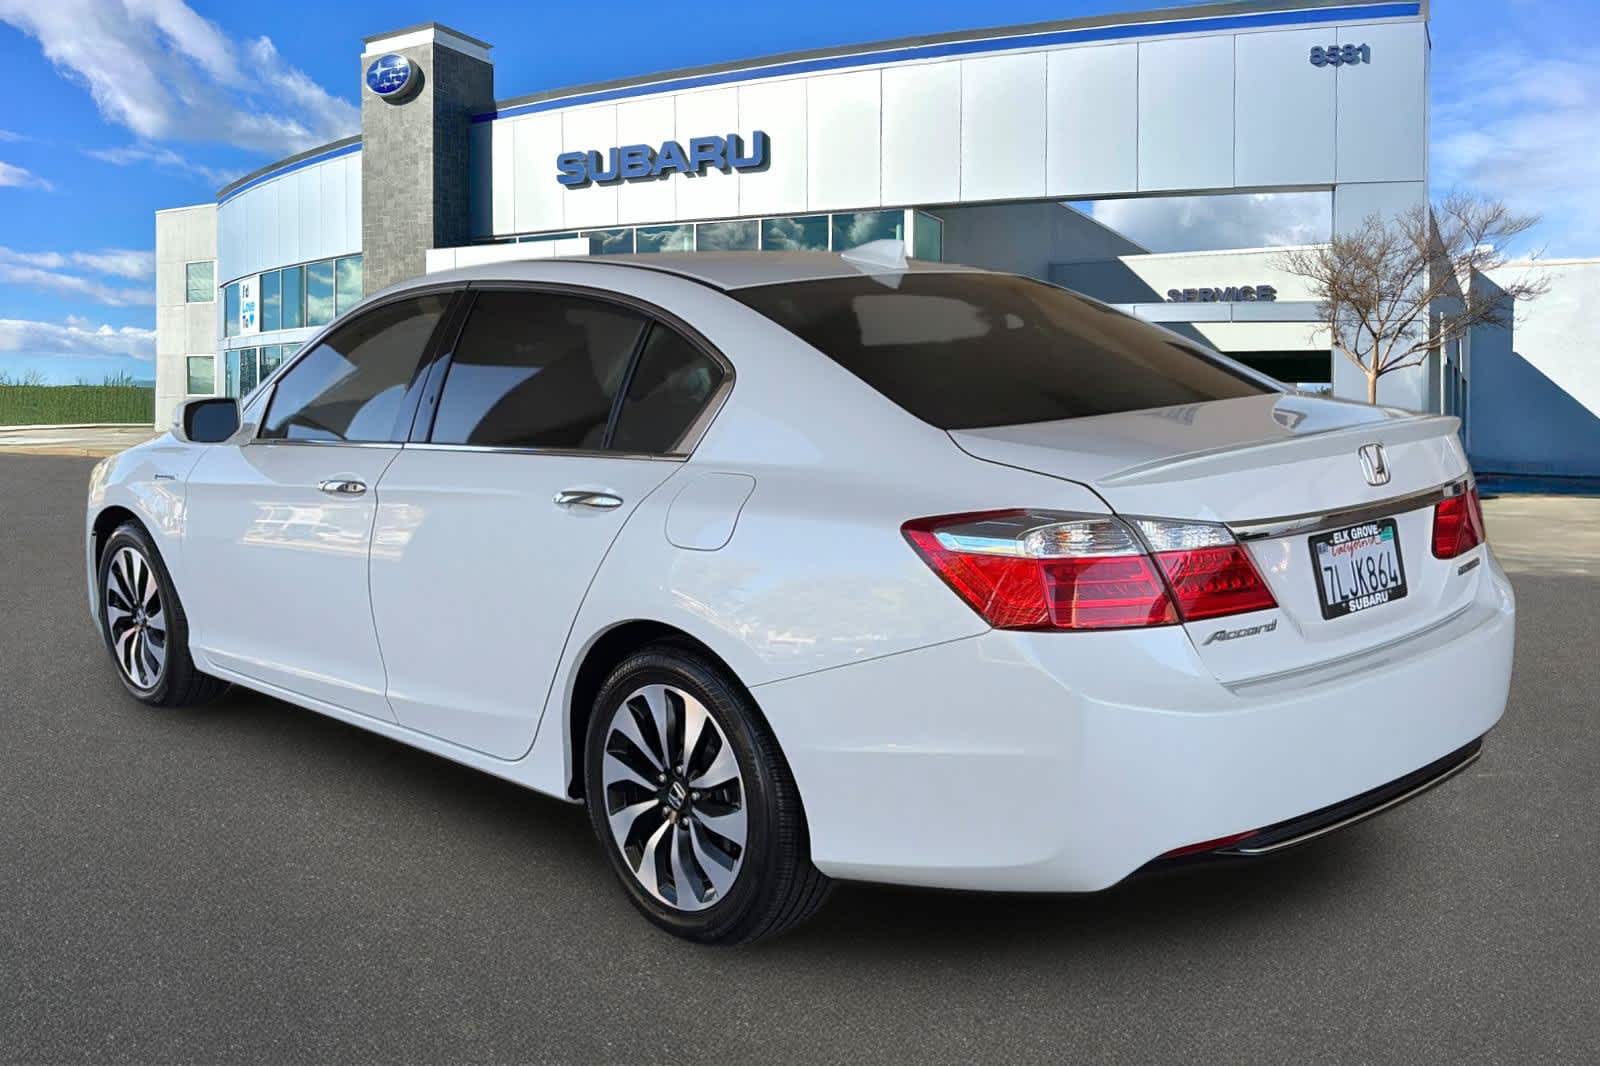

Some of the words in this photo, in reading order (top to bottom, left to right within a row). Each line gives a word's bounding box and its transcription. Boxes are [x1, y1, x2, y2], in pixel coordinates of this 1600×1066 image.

[557, 130, 770, 190] SUBARU
[1166, 285, 1278, 302] SERVICE
[1333, 529, 1350, 545] ELK
[1351, 524, 1379, 541] GROVE
[1323, 551, 1399, 605] 7LJK864
[1349, 591, 1389, 612] SUBARU
[1202, 618, 1278, 646] Accord
